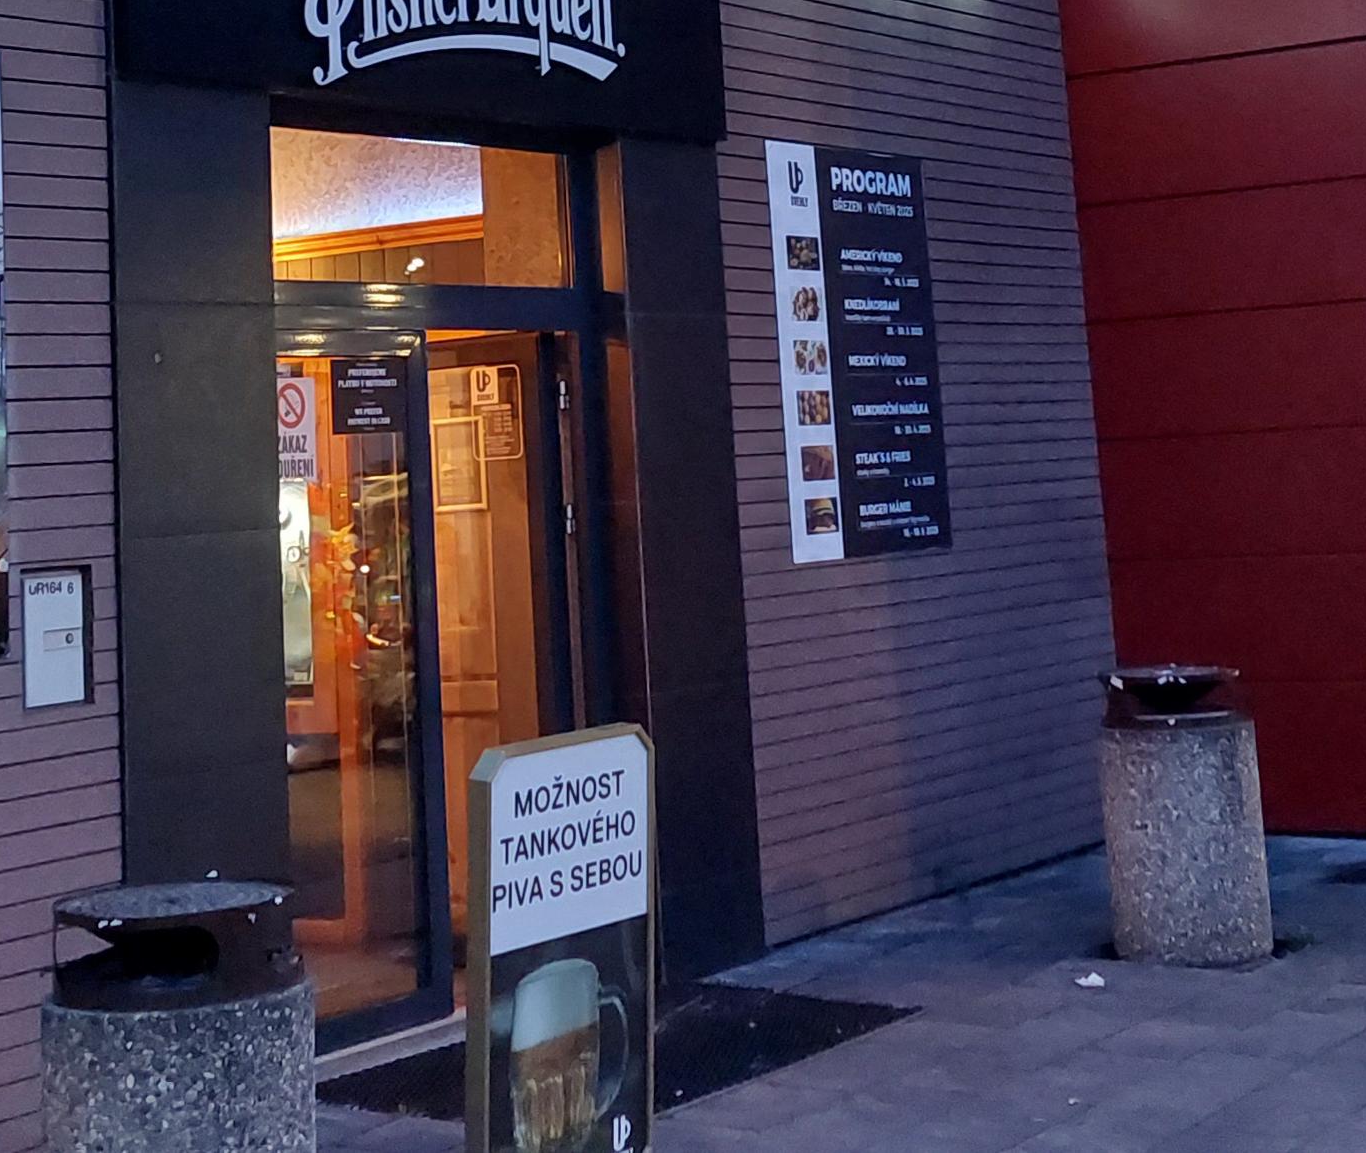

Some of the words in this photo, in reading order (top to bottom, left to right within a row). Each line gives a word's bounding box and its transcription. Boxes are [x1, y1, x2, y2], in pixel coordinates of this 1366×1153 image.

[830, 166, 912, 197] PROGRAM
[514, 769, 626, 819] MOŽNOST
[500, 809, 636, 866] TANKOVÉHO
[491, 874, 544, 913] PIVA
[549, 869, 564, 898] S
[570, 849, 643, 893] SEBOU
